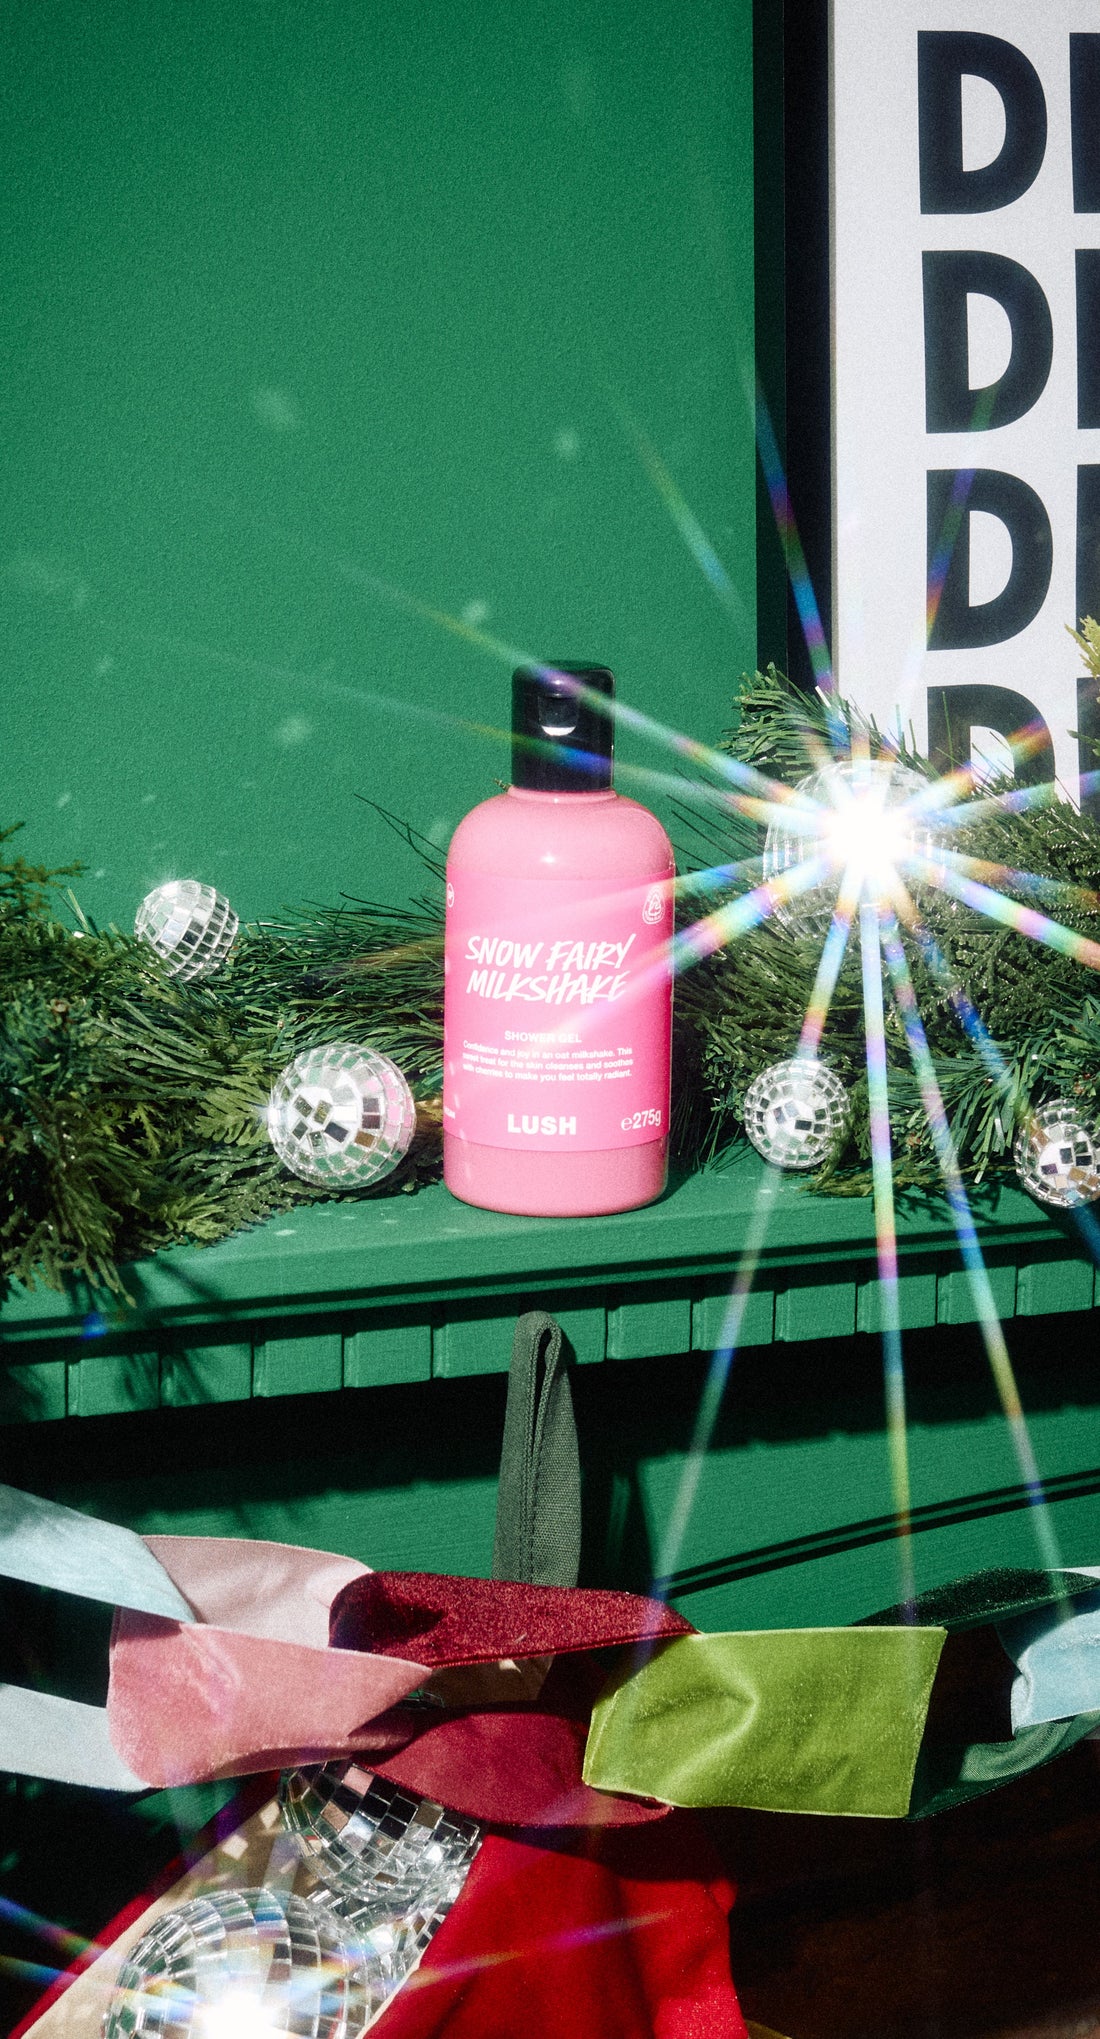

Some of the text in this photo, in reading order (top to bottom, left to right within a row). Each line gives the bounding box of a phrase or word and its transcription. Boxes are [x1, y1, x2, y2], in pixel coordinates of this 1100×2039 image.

[917, 30, 1100, 215] D
[922, 249, 1100, 434] D
[926, 464, 1100, 650] D
[927, 677, 1100, 808] D
[465, 933, 637, 971] SNOW FAIRY
[466, 969, 631, 1005] MILKSHAKE
[463, 1040, 633, 1059] Confidence and joy in an oat milkshake. This
[504, 1030, 582, 1044] SHOWER GEL
[475, 1065, 503, 1077] cherries
[504, 1069, 513, 1079] to
[515, 1070, 538, 1081] make
[540, 1072, 556, 1083] you
[558, 1070, 574, 1081] feel
[576, 1070, 602, 1082] totally
[604, 1069, 632, 1080] radiant.
[480, 1054, 496, 1065] treat
[498, 1057, 509, 1067] for
[510, 1059, 523, 1069] the
[526, 1059, 543, 1070] skin
[545, 1060, 585, 1070] cleanses
[586, 1060, 602, 1070] and
[603, 1058, 633, 1069] soothes
[507, 1113, 577, 1136] LUSH
